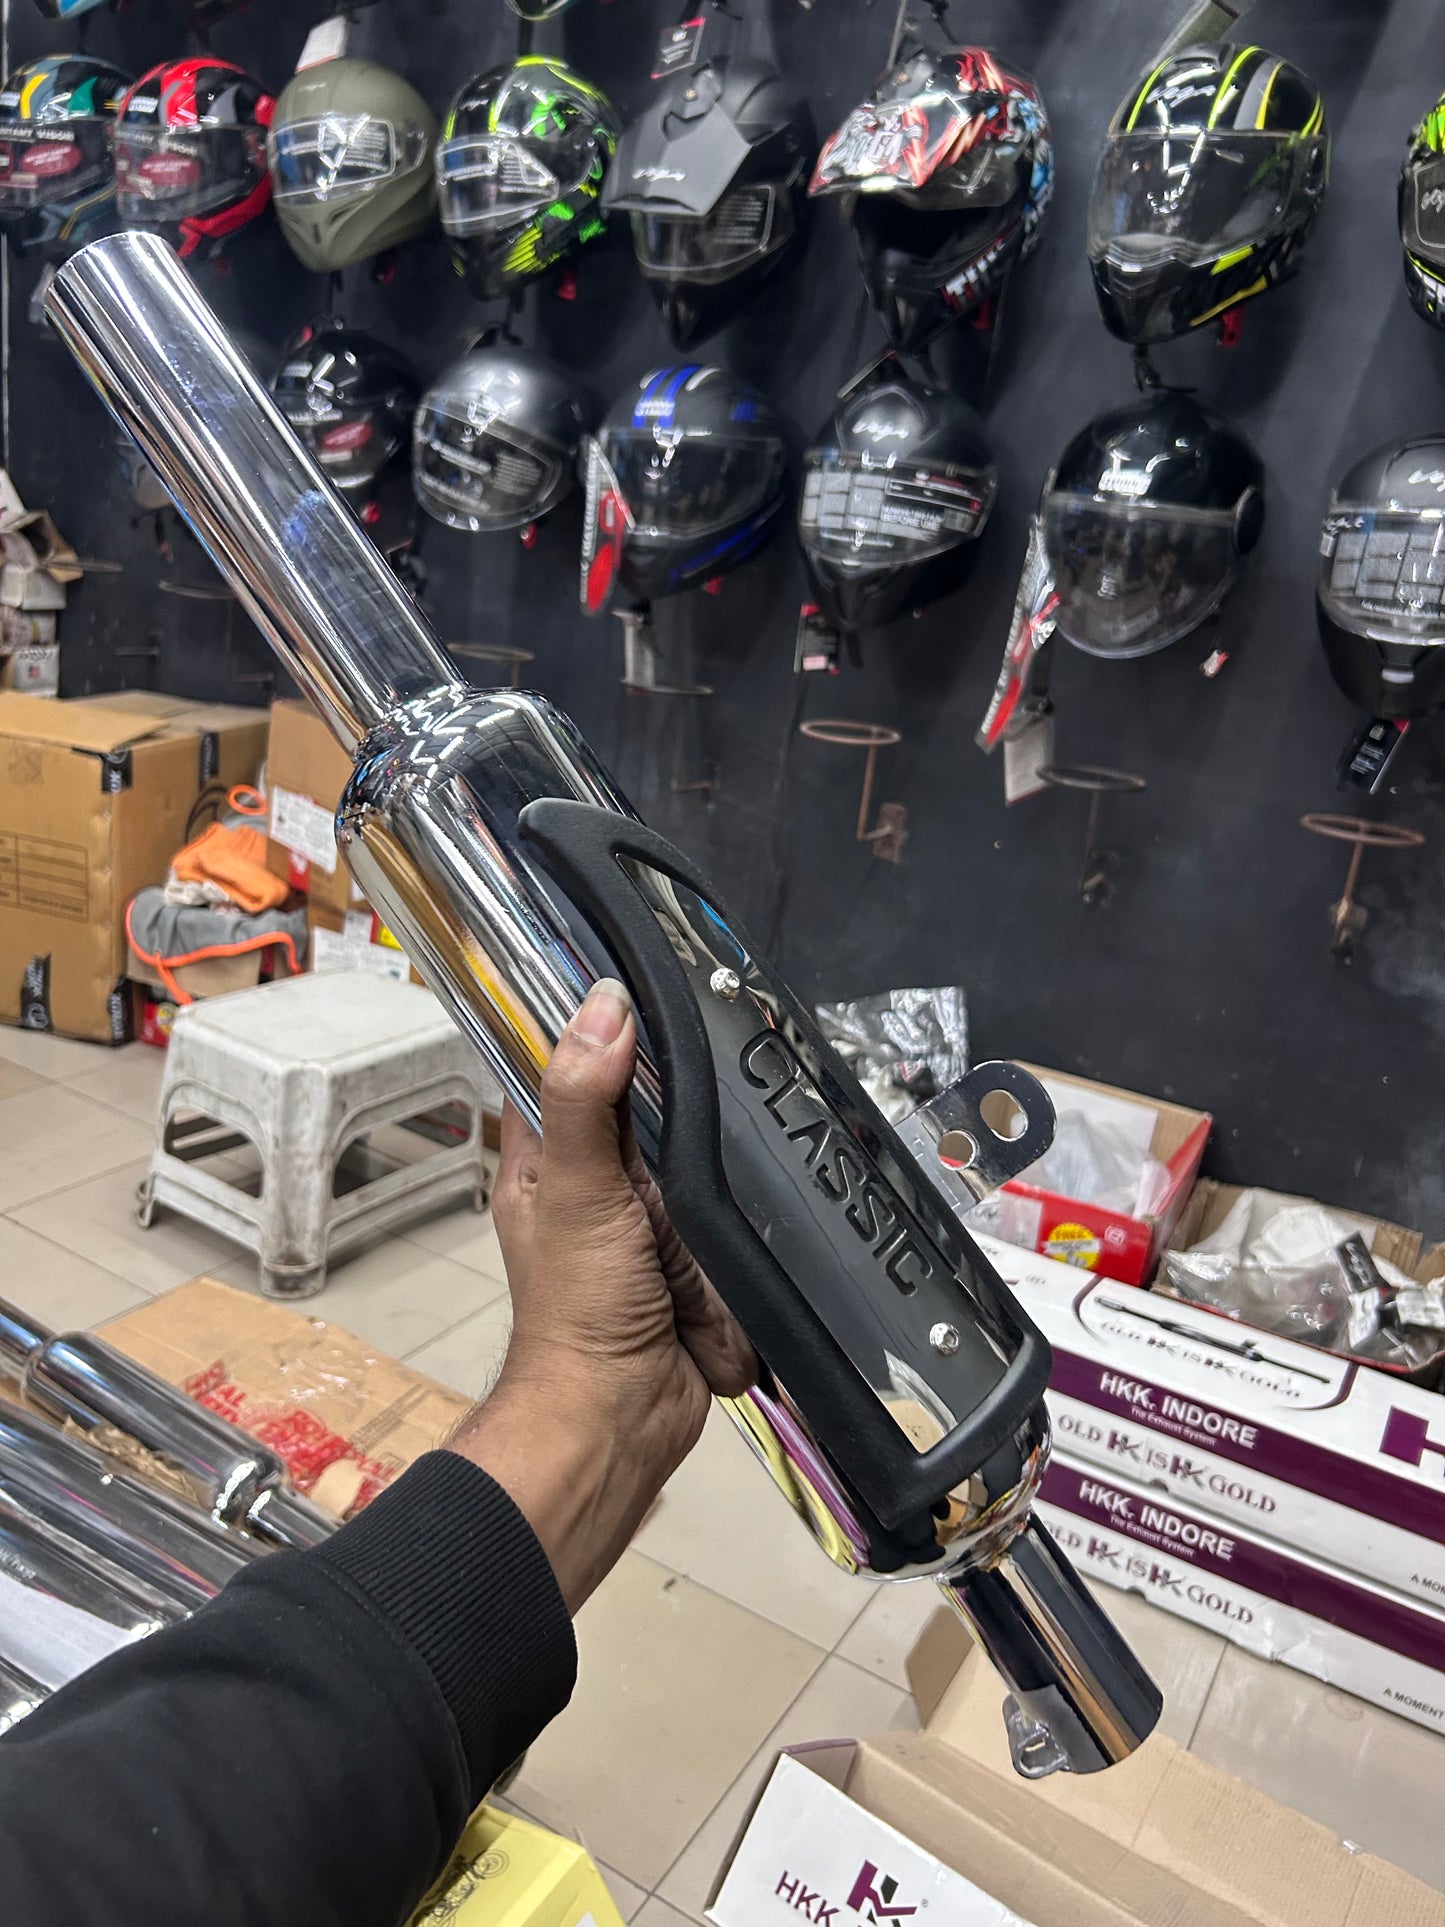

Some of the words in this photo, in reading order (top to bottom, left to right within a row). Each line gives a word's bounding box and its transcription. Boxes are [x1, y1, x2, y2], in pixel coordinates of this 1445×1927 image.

[739, 1028, 933, 1297] CLASSIC
[1131, 1406, 1147, 1419] The
[1183, 1426, 1218, 1448] System
[1161, 1394, 1260, 1450] INDORE
[1057, 1414, 1102, 1444] OLD
[1145, 1449, 1169, 1471] IS
[1208, 1474, 1277, 1514] GOLD
[1110, 1516, 1126, 1528] The
[1160, 1536, 1196, 1557] System
[1139, 1504, 1236, 1562] INDORE
[1125, 1556, 1148, 1578] IS
[1187, 1584, 1254, 1625] GOLD
[1411, 1573, 1419, 1584] A
[1383, 1687, 1392, 1697] A
[1395, 1691, 1445, 1720] MOMENT
[775, 1870, 841, 1927] HKK
